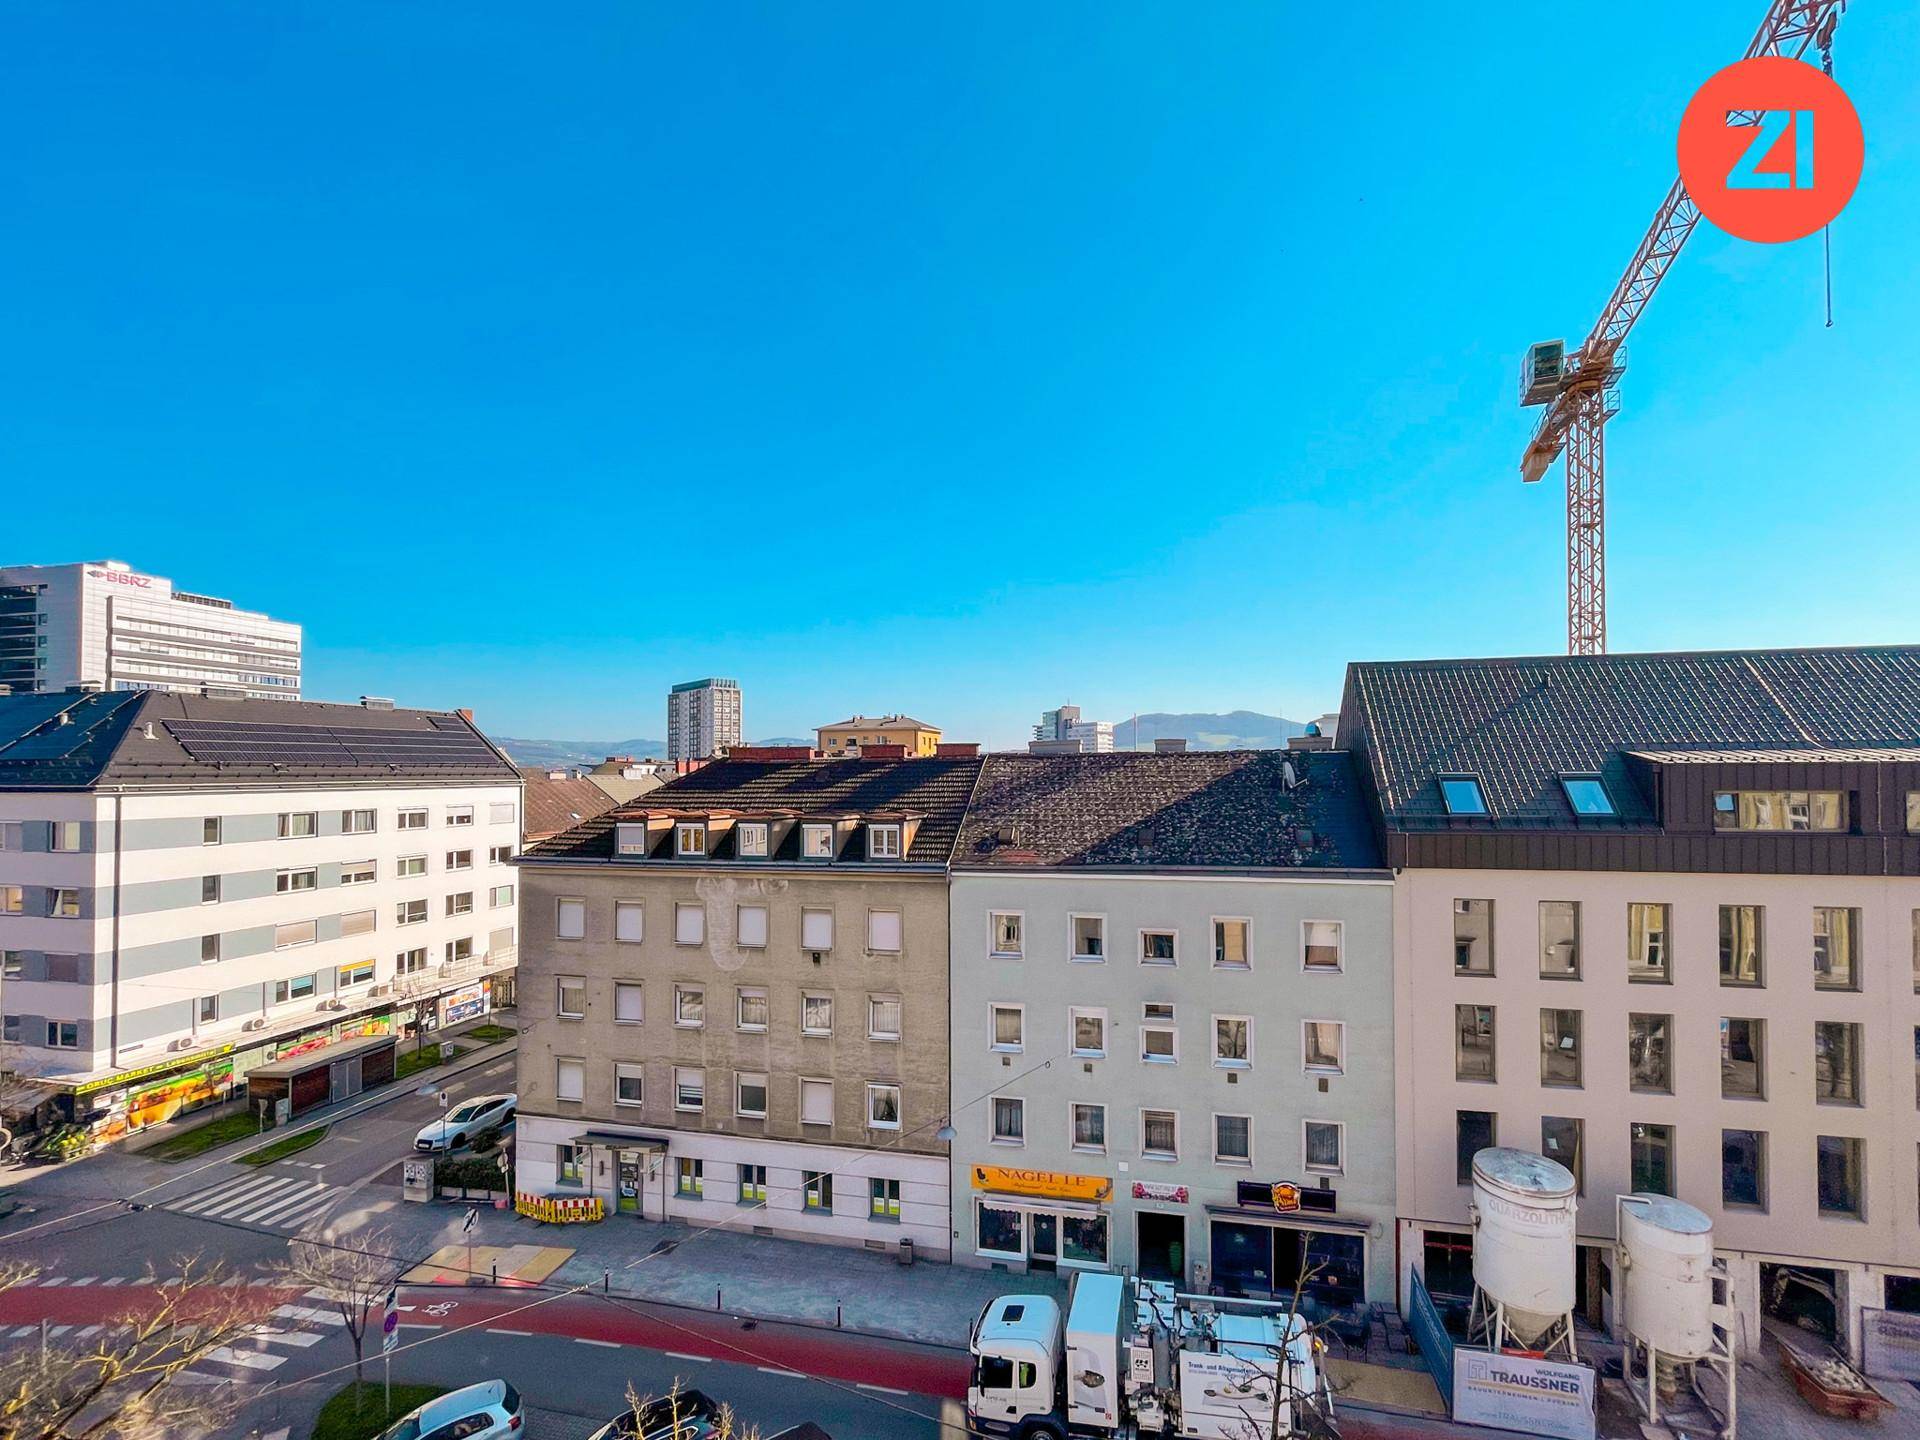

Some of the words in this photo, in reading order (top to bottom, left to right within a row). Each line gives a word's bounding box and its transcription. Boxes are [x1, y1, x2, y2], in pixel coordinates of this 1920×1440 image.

[106, 571, 152, 588] BBRZ
[116, 1066, 155, 1081] MARKET
[1490, 1370, 1580, 1394] TRAUSSNER
[1535, 1368, 1581, 1381] WOLFGANG
